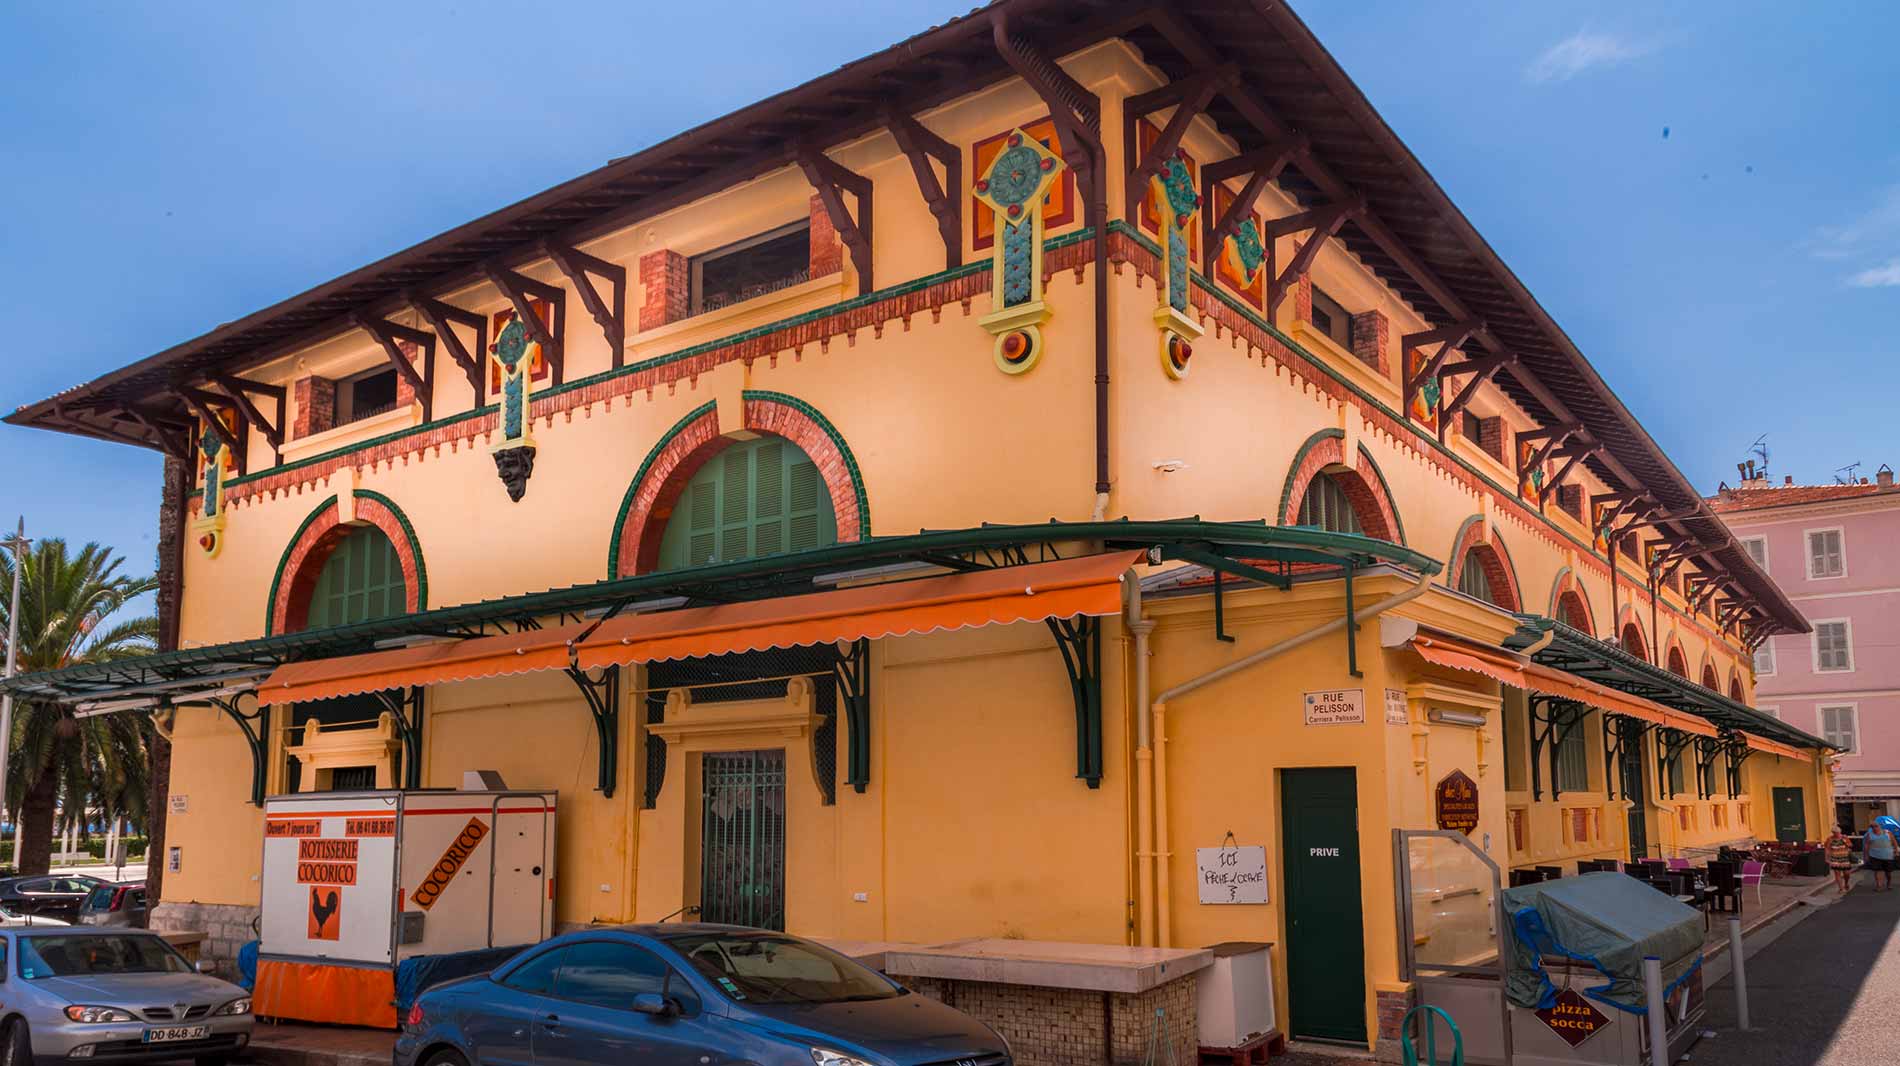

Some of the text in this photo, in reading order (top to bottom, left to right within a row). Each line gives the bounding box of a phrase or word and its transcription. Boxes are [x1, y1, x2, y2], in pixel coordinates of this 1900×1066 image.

[1323, 693, 1344, 702] RUE
[1313, 703, 1354, 714] PELISSON
[1335, 714, 1361, 722] Pelisson
[267, 822, 320, 837] Ouvert 7 jours sur 7
[301, 839, 357, 859] ROTISSERIE
[1310, 847, 1340, 857] PRIVE
[415, 824, 482, 906] COCORICO
[1218, 851, 1239, 867] ICI
[298, 862, 354, 883] COCORICO
[1552, 1003, 1591, 1015] pizza
[1550, 1018, 1594, 1030] socca
